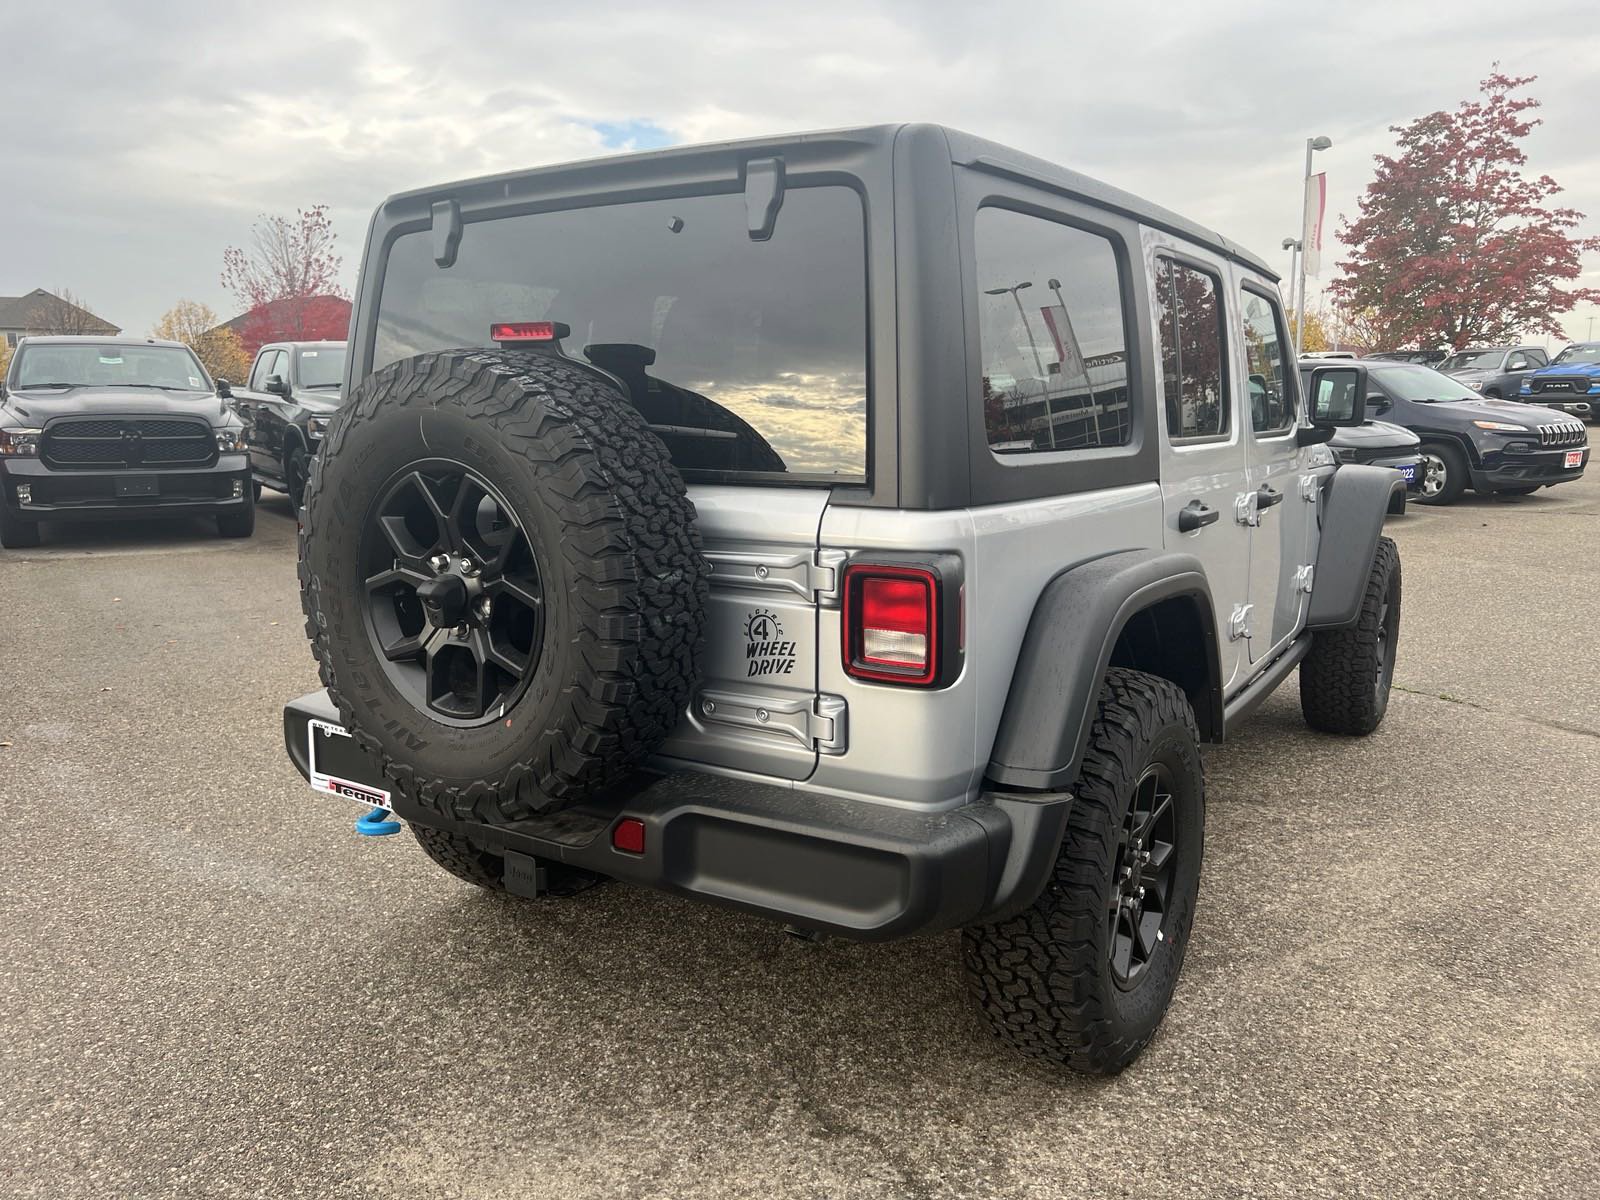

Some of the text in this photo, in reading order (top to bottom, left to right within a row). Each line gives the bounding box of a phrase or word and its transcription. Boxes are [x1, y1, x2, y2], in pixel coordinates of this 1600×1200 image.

[1401, 468, 1415, 479] 022
[753, 618, 769, 641] 4
[746, 641, 797, 659] WHEEL
[747, 658, 796, 678] DRIVE
[330, 781, 384, 807] Team
